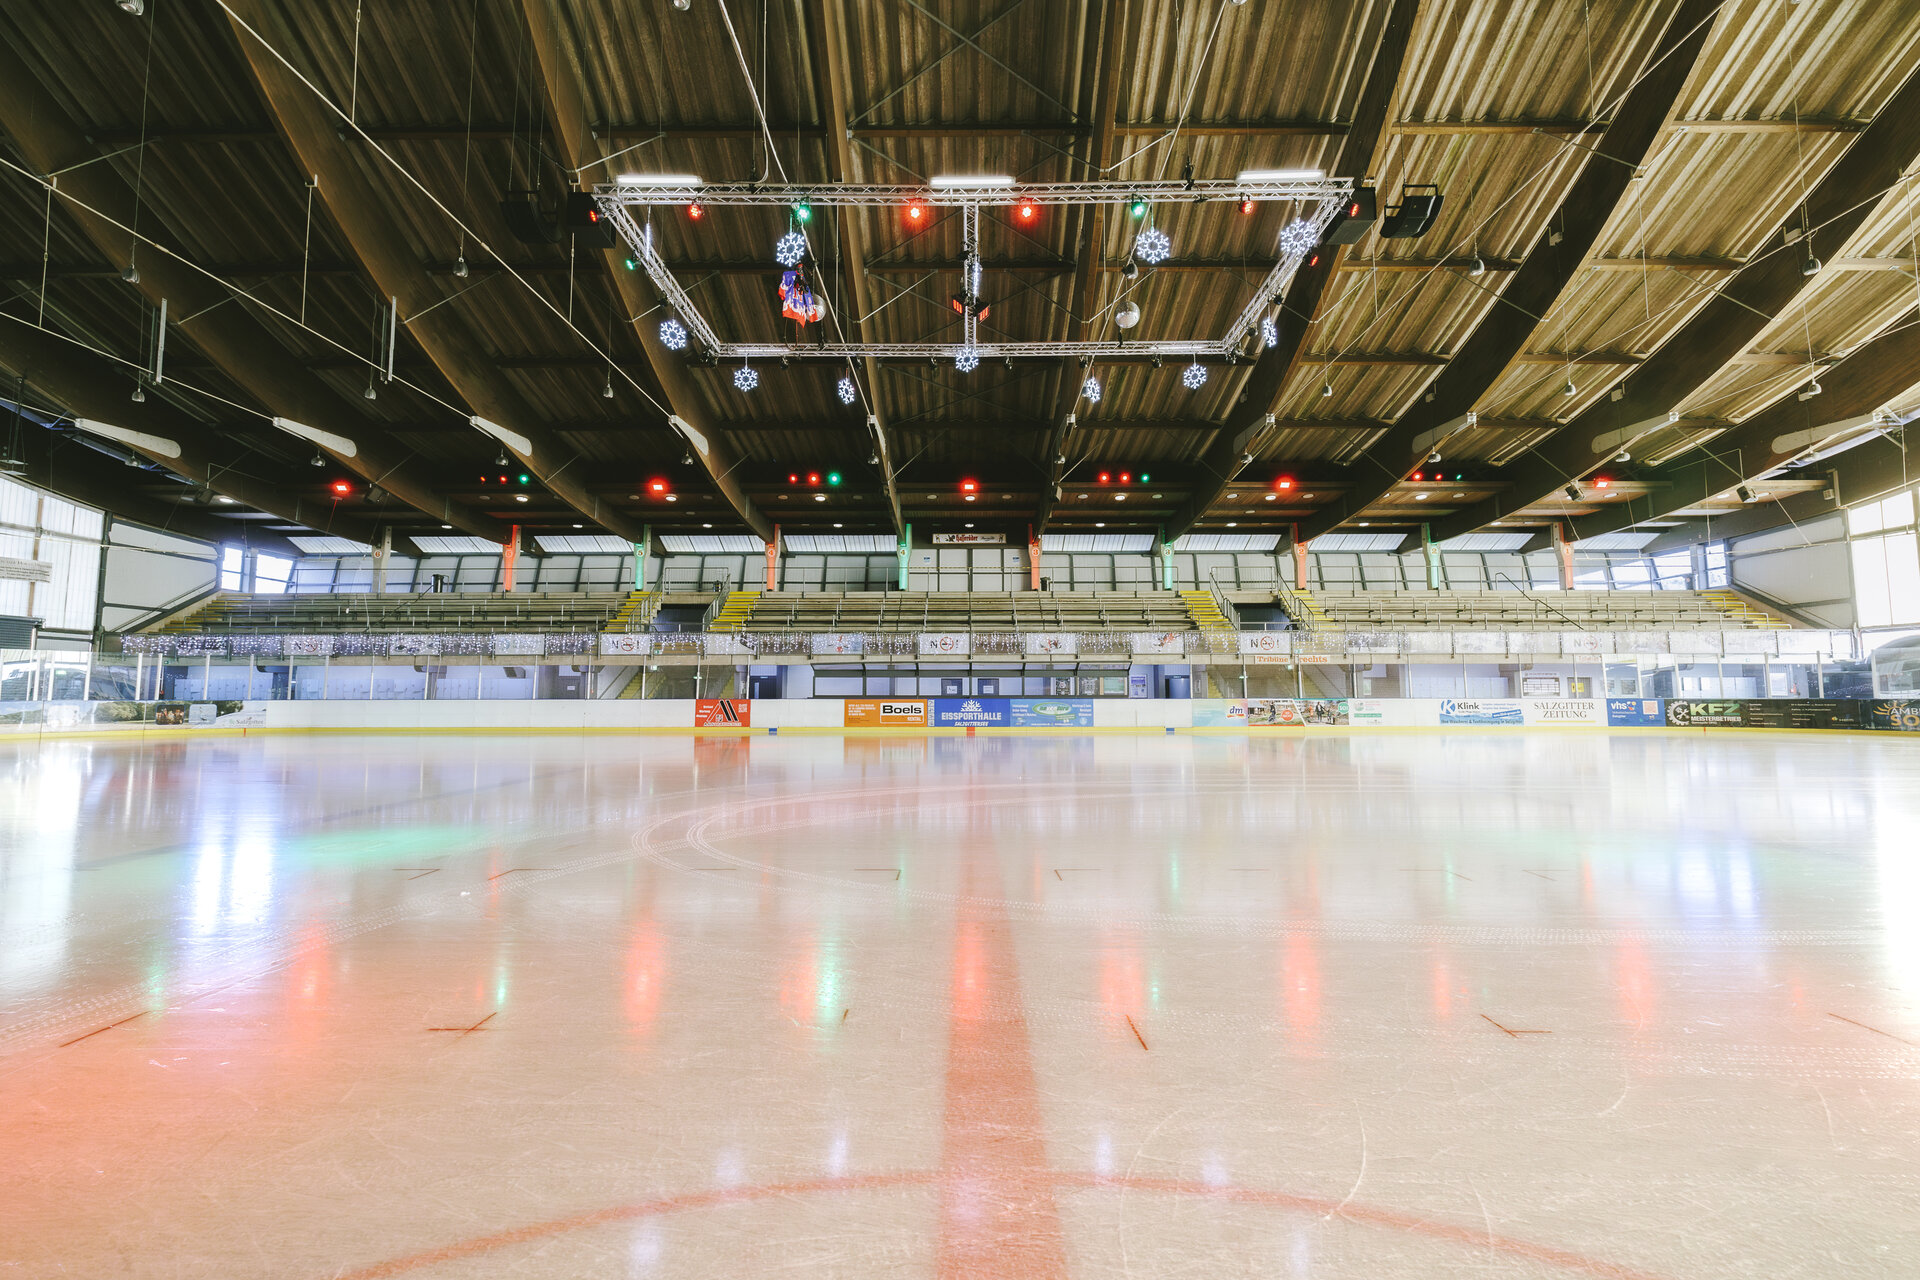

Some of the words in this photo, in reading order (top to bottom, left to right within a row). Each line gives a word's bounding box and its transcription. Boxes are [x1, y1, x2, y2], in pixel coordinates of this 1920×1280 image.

[882, 704, 922, 714] Boels
[1457, 702, 1480, 710] Klink
[1610, 701, 1627, 709] vhs
[1229, 705, 1243, 714] dm
[1689, 703, 1741, 716] KFZ
[1890, 707, 1920, 715] AMB
[941, 712, 1002, 720] EISSPORTHALLE
